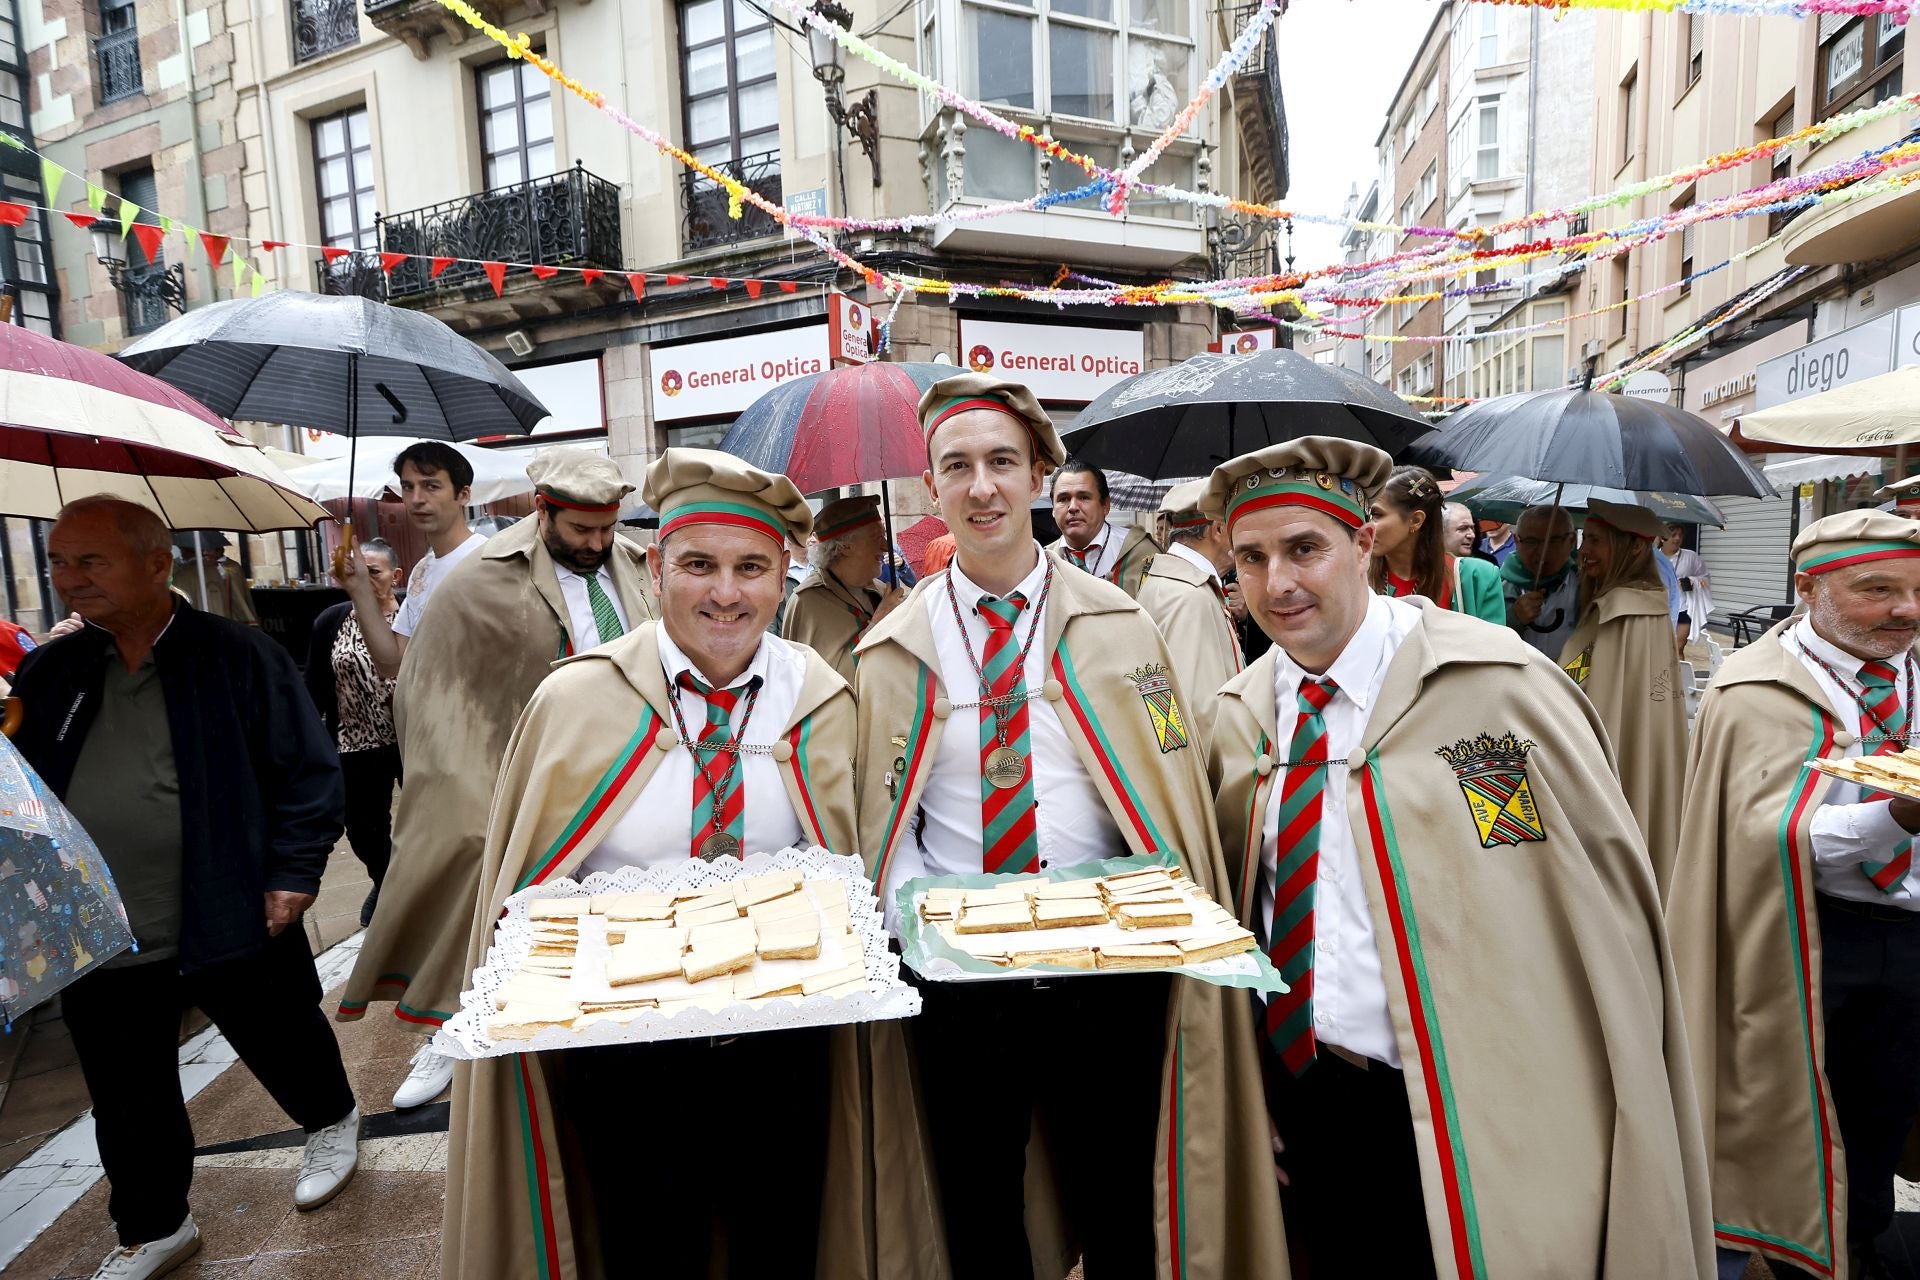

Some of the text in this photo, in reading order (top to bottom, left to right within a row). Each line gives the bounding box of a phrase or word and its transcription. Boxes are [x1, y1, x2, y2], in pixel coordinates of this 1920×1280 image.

[794, 191, 817, 203] CALLE
[842, 329, 868, 347] Genera
[845, 342, 868, 359] Optica
[687, 357, 821, 389] General Optica
[1000, 350, 1139, 377] General Optica
[1787, 347, 1849, 395] diego
[1625, 386, 1669, 396] miramira
[1151, 710, 1163, 731] AVE
[1472, 799, 1492, 824] AVE
[1516, 789, 1536, 824] MARIA
